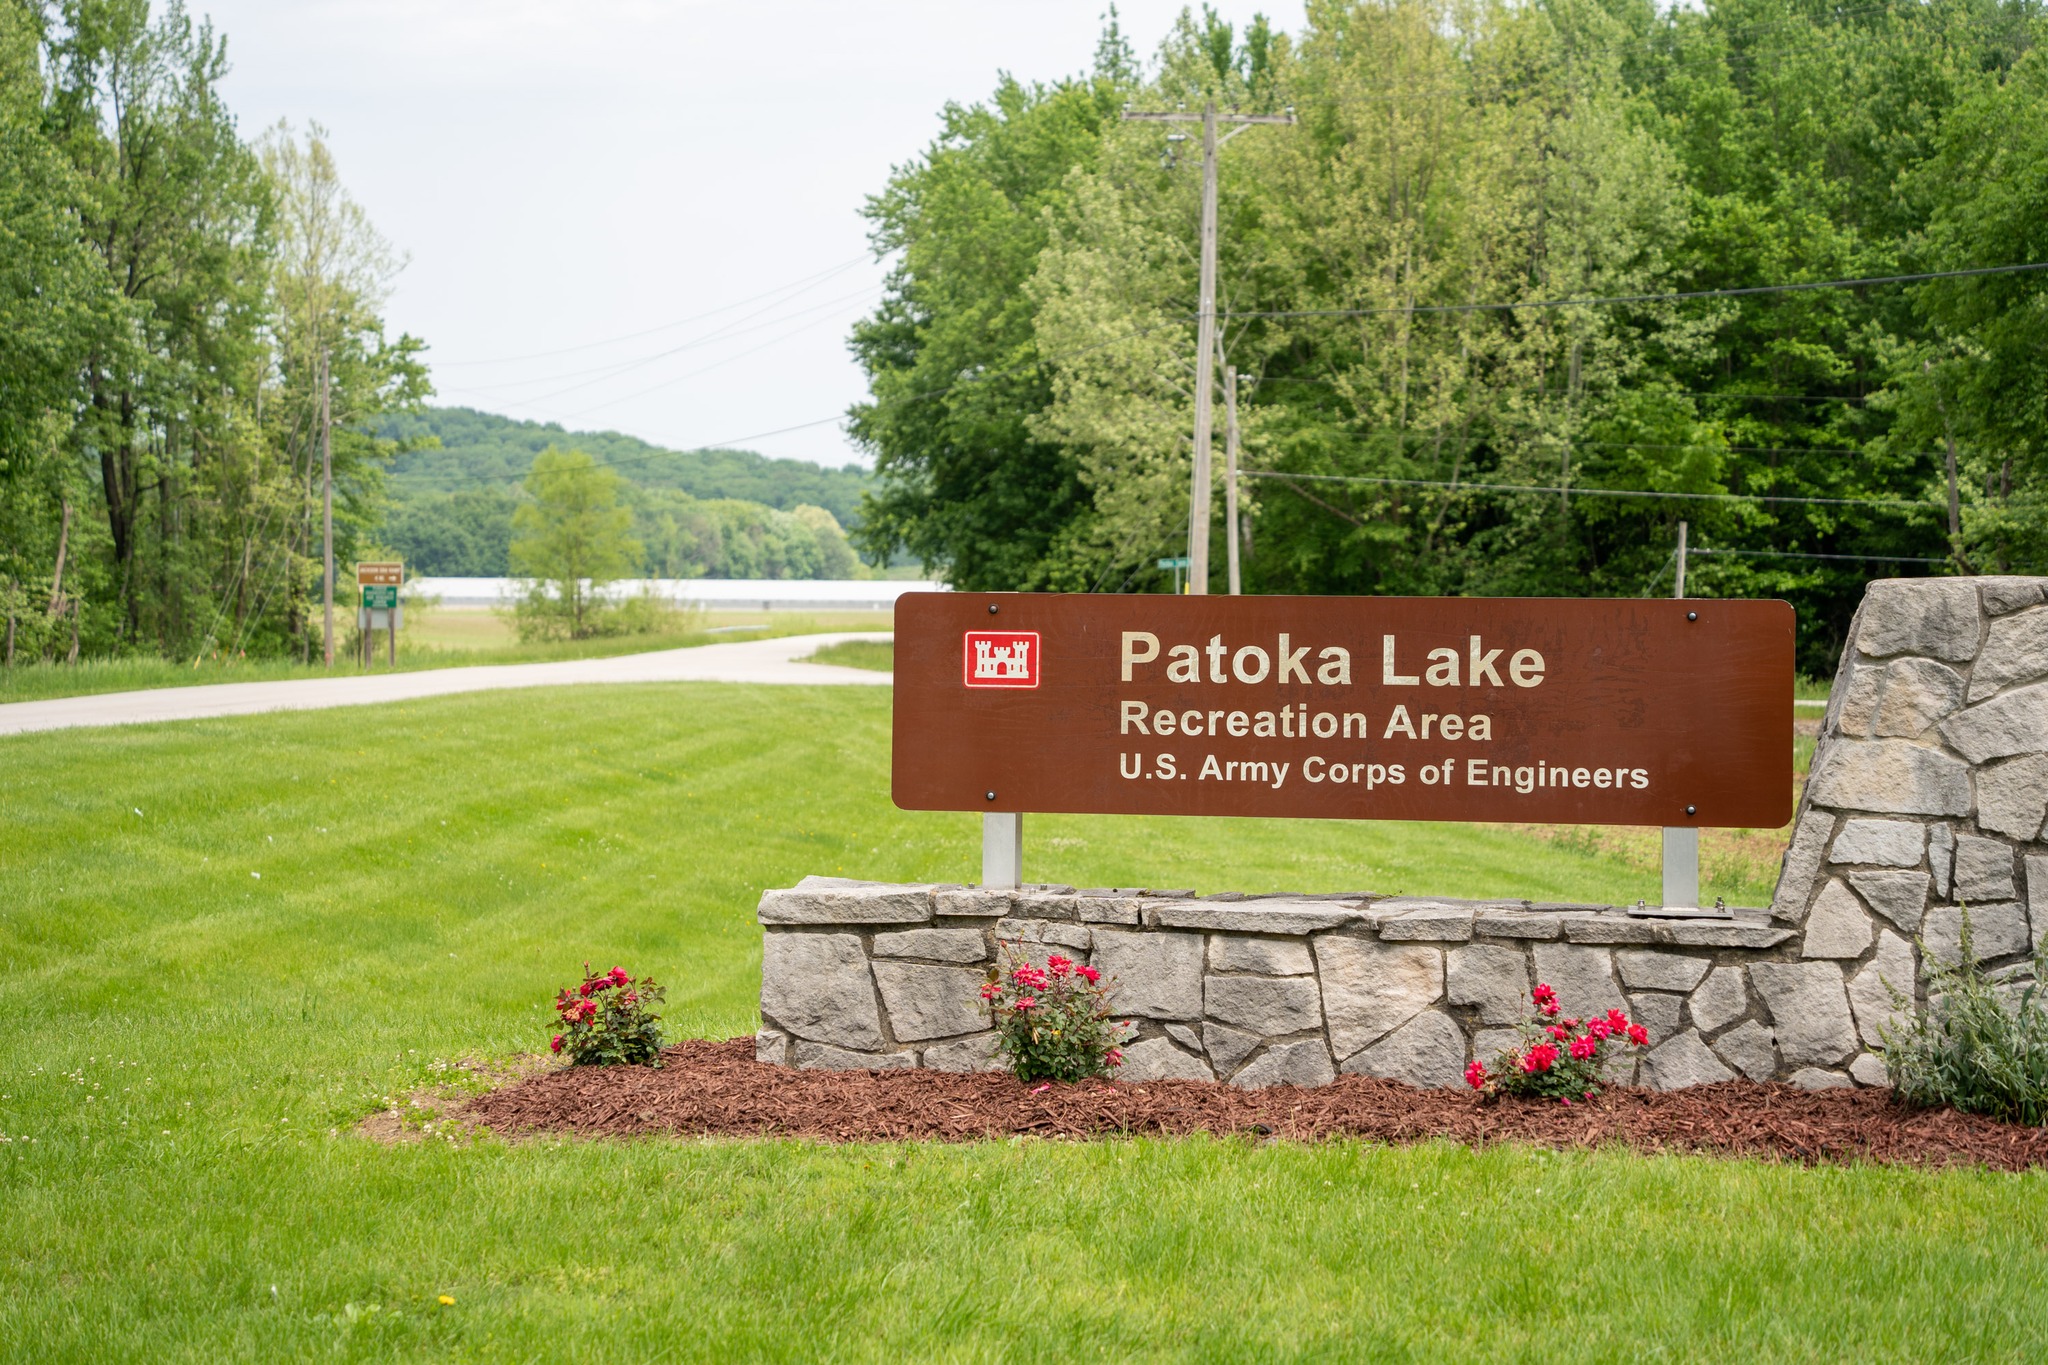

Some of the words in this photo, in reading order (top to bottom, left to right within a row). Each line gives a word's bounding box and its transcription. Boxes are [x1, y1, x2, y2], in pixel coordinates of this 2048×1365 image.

[1121, 631, 1352, 686] Patoka
[1382, 634, 1546, 688] Lake
[1120, 700, 1367, 740] Recreation
[1383, 704, 1492, 741] Area
[1120, 752, 1187, 781] U.S.
[1199, 754, 1290, 790] Army
[1302, 755, 1406, 791] Corps
[1419, 758, 1456, 786] of
[1467, 758, 1649, 794] Engineers
